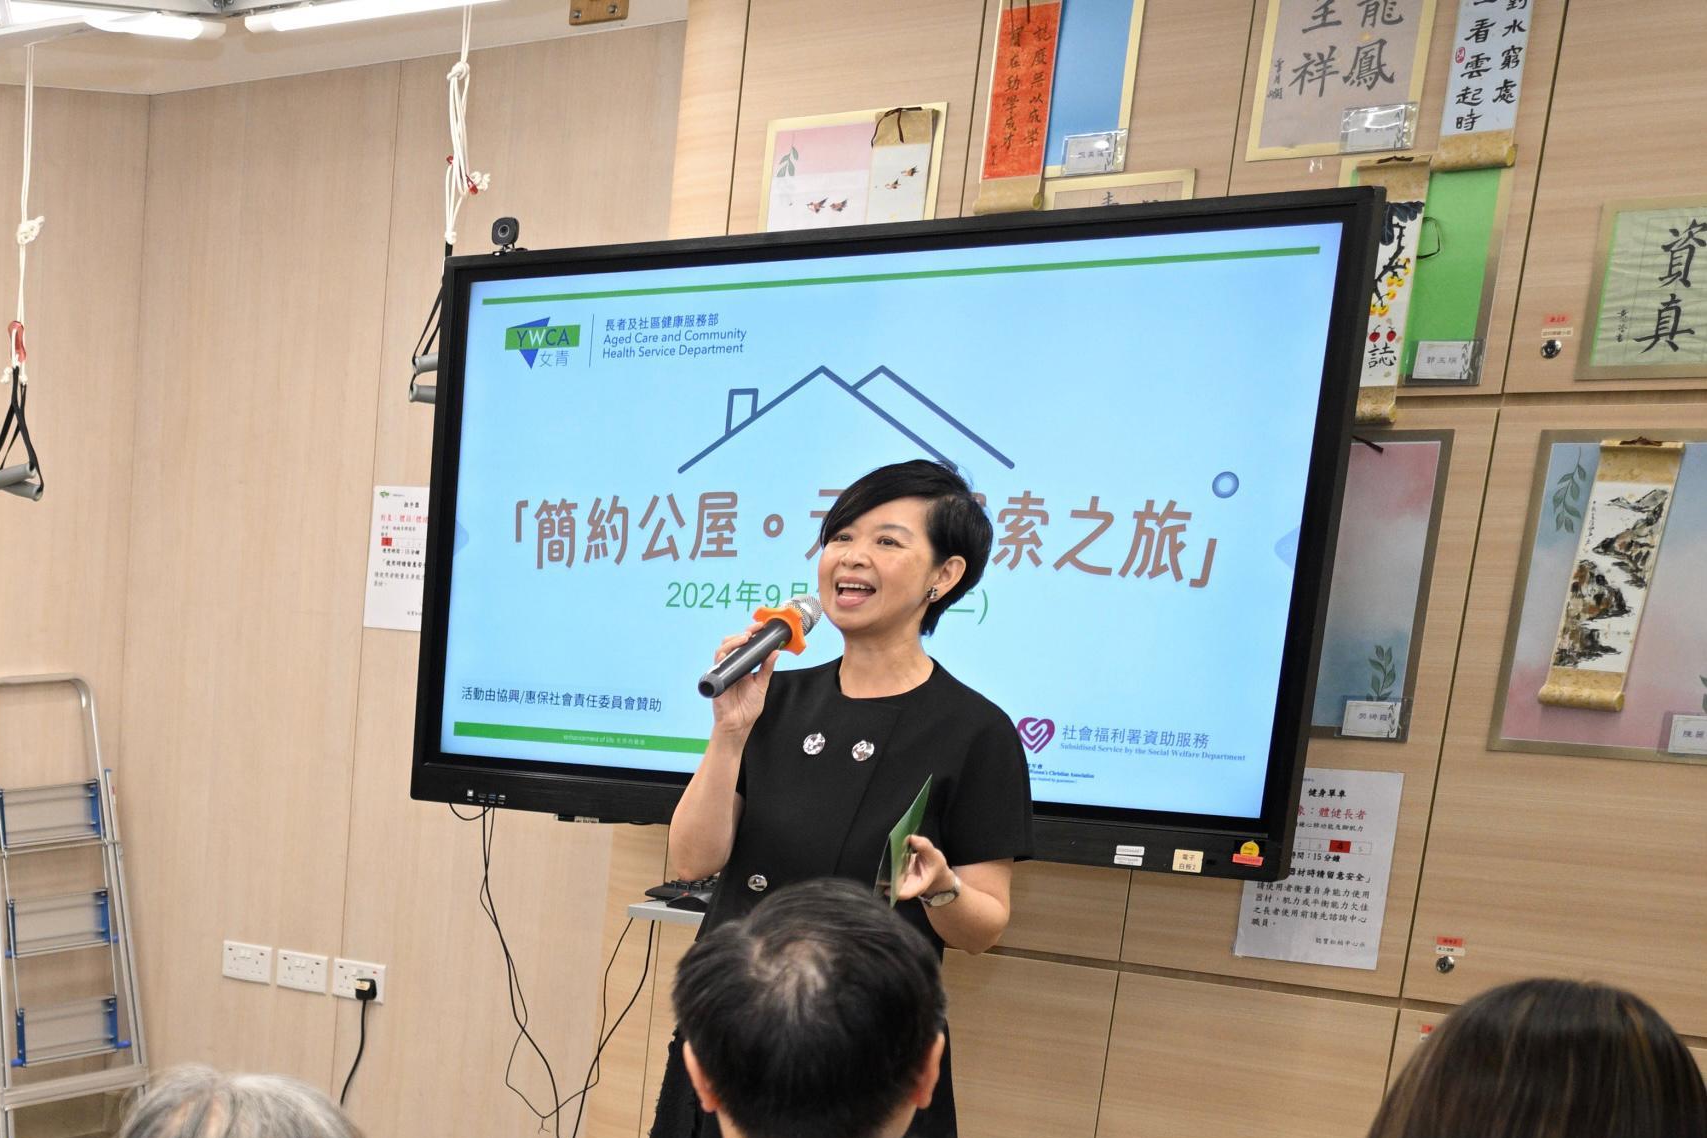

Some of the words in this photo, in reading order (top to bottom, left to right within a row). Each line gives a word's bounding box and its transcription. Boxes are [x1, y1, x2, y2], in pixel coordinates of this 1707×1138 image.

[1455, 0, 1496, 131] 看雲起時
[604, 313, 719, 332] 長者及社區健康服務部
[516, 328, 570, 347] YWCA
[603, 332, 633, 347] Aged
[634, 331, 659, 344] Care
[661, 329, 682, 342] and
[684, 328, 747, 342] Community
[539, 350, 570, 368] 文青
[602, 347, 636, 359] Health
[638, 345, 677, 358] Service
[679, 343, 744, 357] Department
[1062, 724, 1210, 750] 社會福利署資助服務
[1060, 742, 1097, 752] Subsidised
[1097, 744, 1123, 754] Service
[1124, 745, 1134, 756] by
[1135, 746, 1147, 755] the
[1148, 747, 1170, 757] Social
[1171, 748, 1200, 759] Welfare
[1201, 750, 1246, 761] Department
